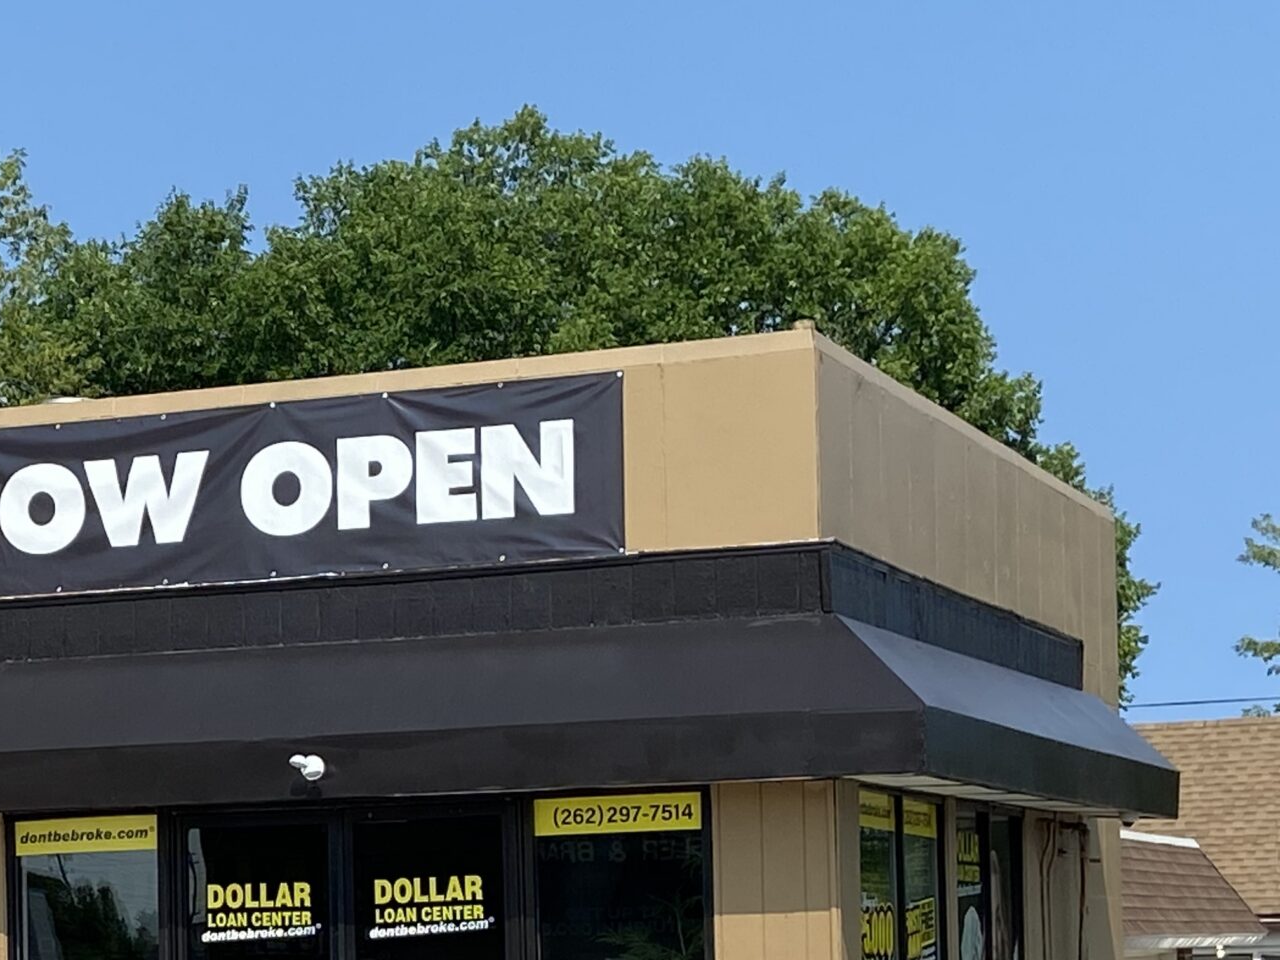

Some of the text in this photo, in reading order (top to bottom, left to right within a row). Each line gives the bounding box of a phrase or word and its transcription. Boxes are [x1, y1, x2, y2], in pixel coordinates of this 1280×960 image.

[240, 419, 575, 537] OPEN
[207, 882, 311, 909] DOLLAR
[374, 875, 483, 904] DOLLAR
[207, 911, 312, 927] LOAN CENTER
[375, 905, 484, 924] LOAN CENTER
